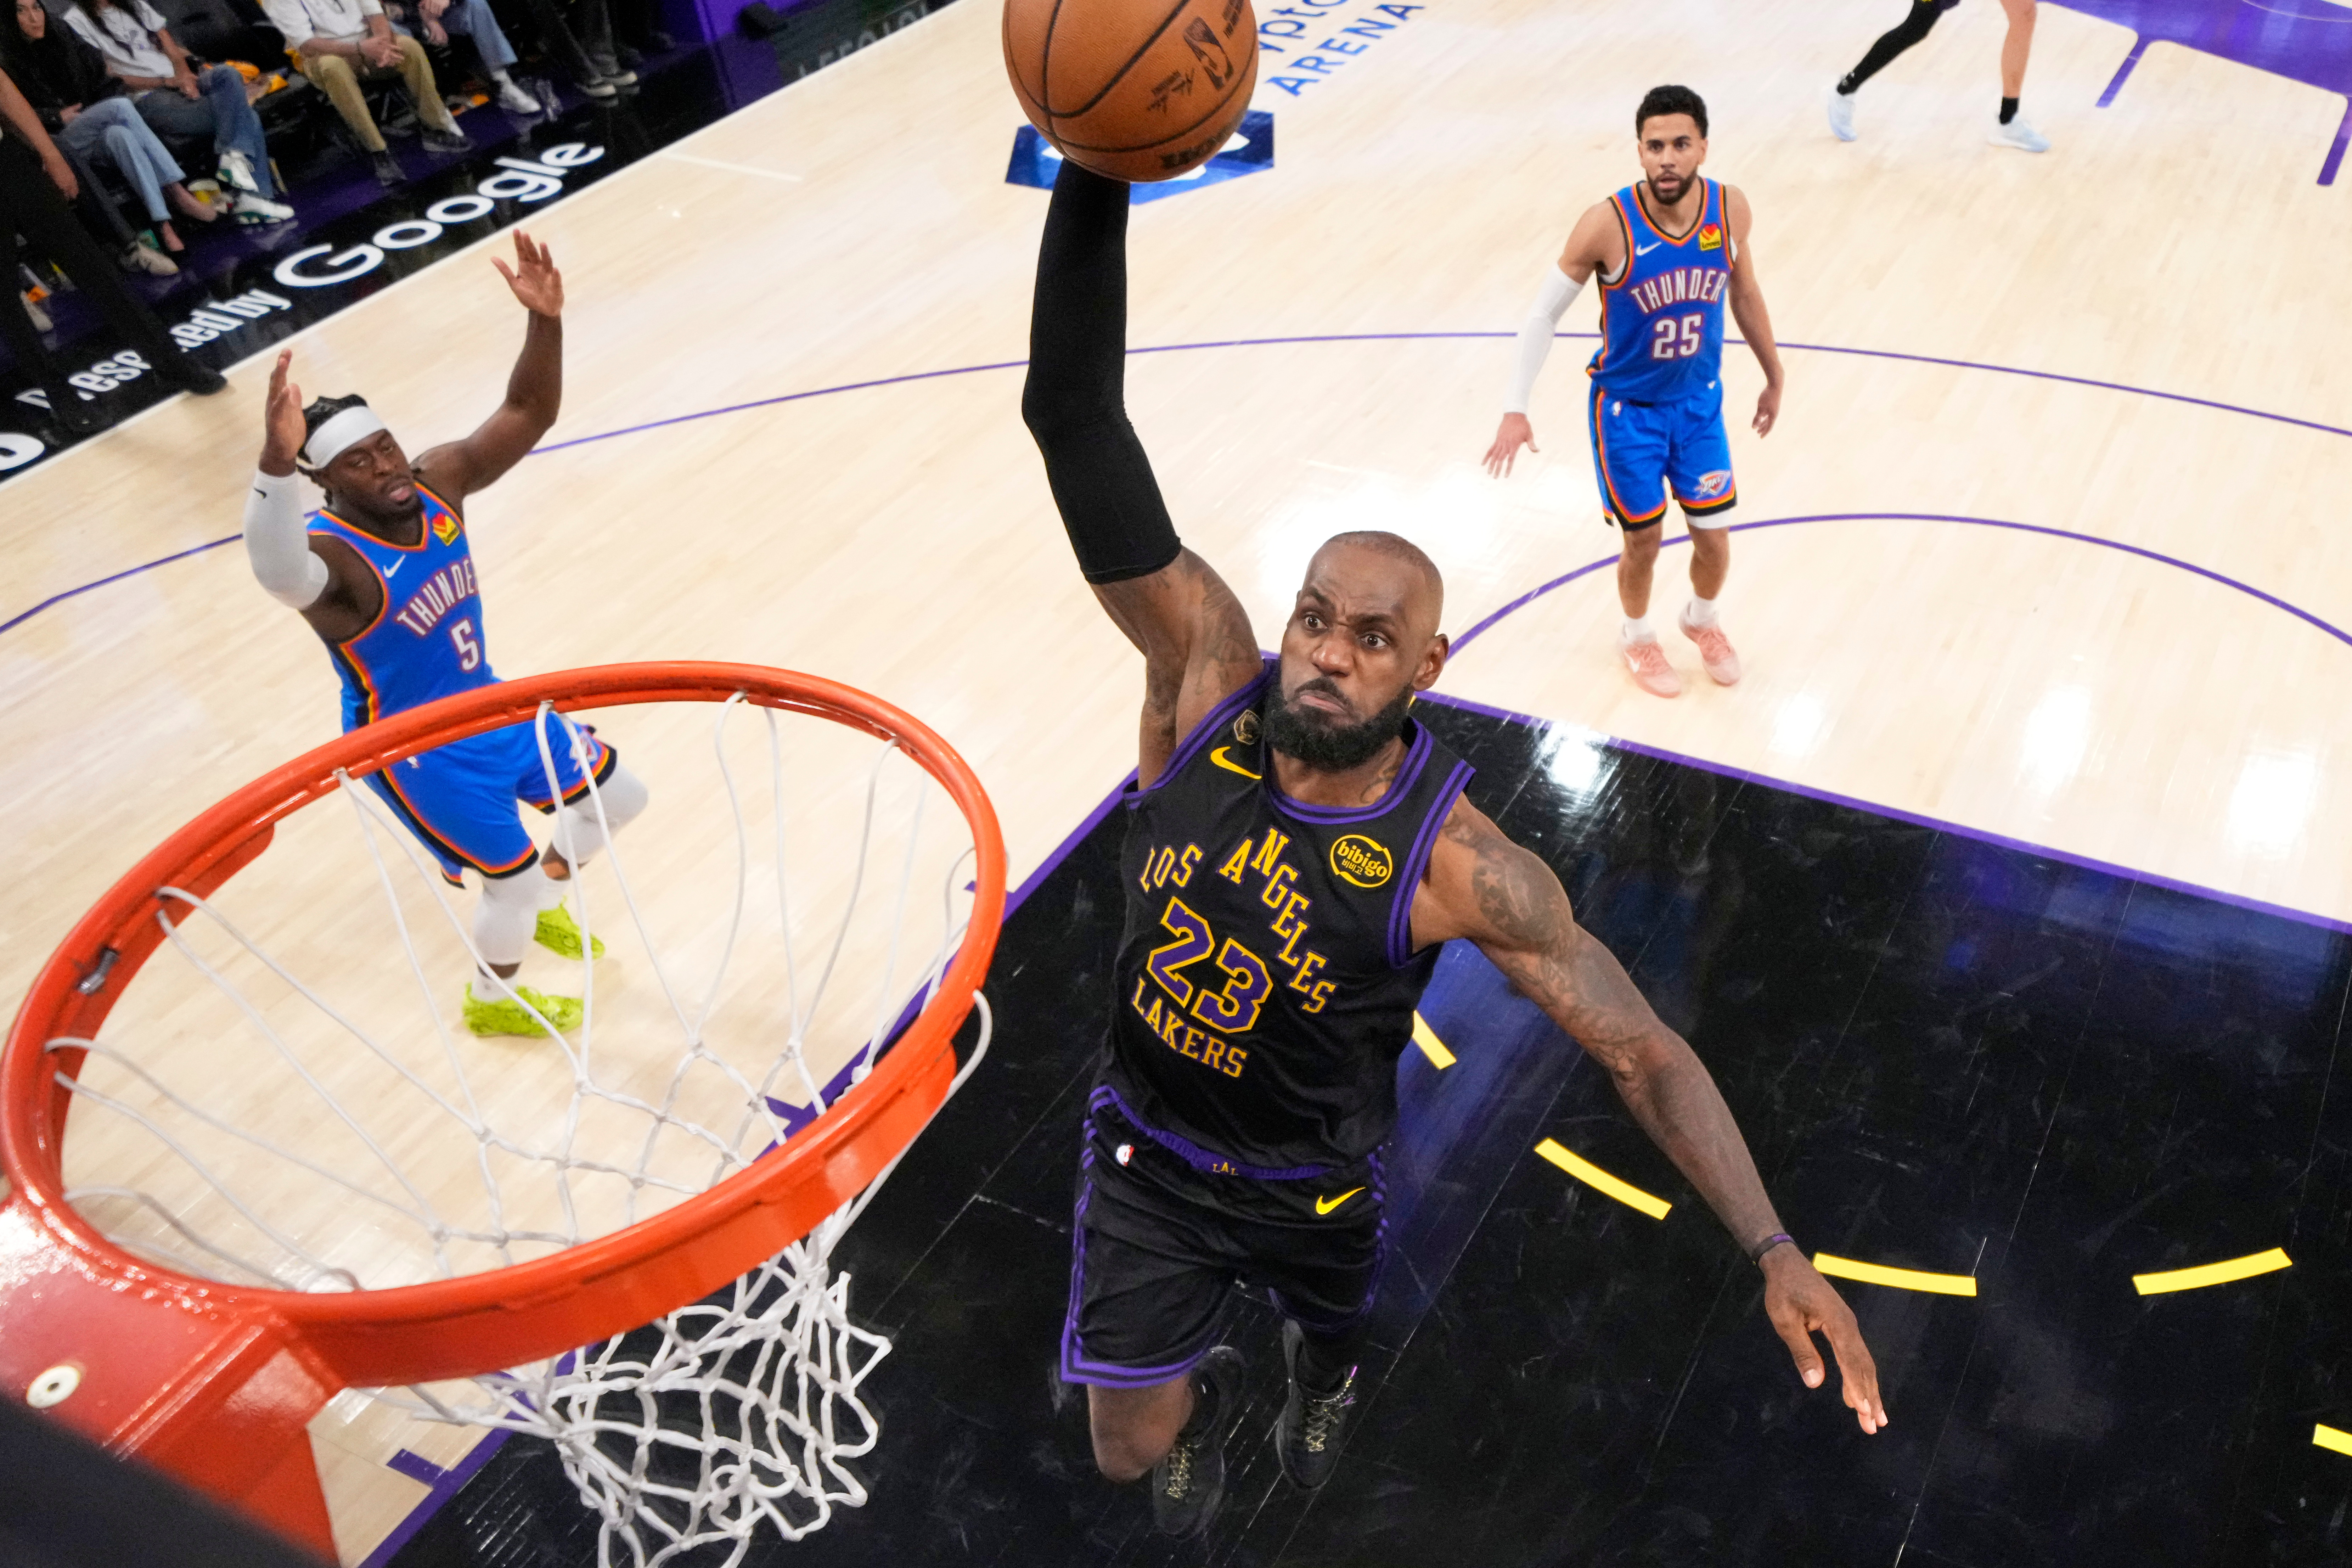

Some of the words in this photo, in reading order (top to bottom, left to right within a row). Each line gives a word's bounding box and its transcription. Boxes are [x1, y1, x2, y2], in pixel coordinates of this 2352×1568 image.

[1265, 4, 1426, 97] ARENA
[208, 288, 292, 319] by
[274, 142, 604, 287] Google
[1631, 269, 1728, 314] THUNDER
[1653, 315, 1702, 359] 25
[396, 558, 478, 636] THUNDE
[451, 619, 479, 671] 5
[1337, 841, 1388, 877] bibigo
[1341, 859, 1364, 876] 비비고
[1140, 844, 1203, 893] LOS
[1218, 828, 1337, 1013] ANGELES
[1147, 896, 1274, 1033] 23
[1133, 978, 1248, 1078] LAKERS
[1213, 1162, 1239, 1176] LAL
